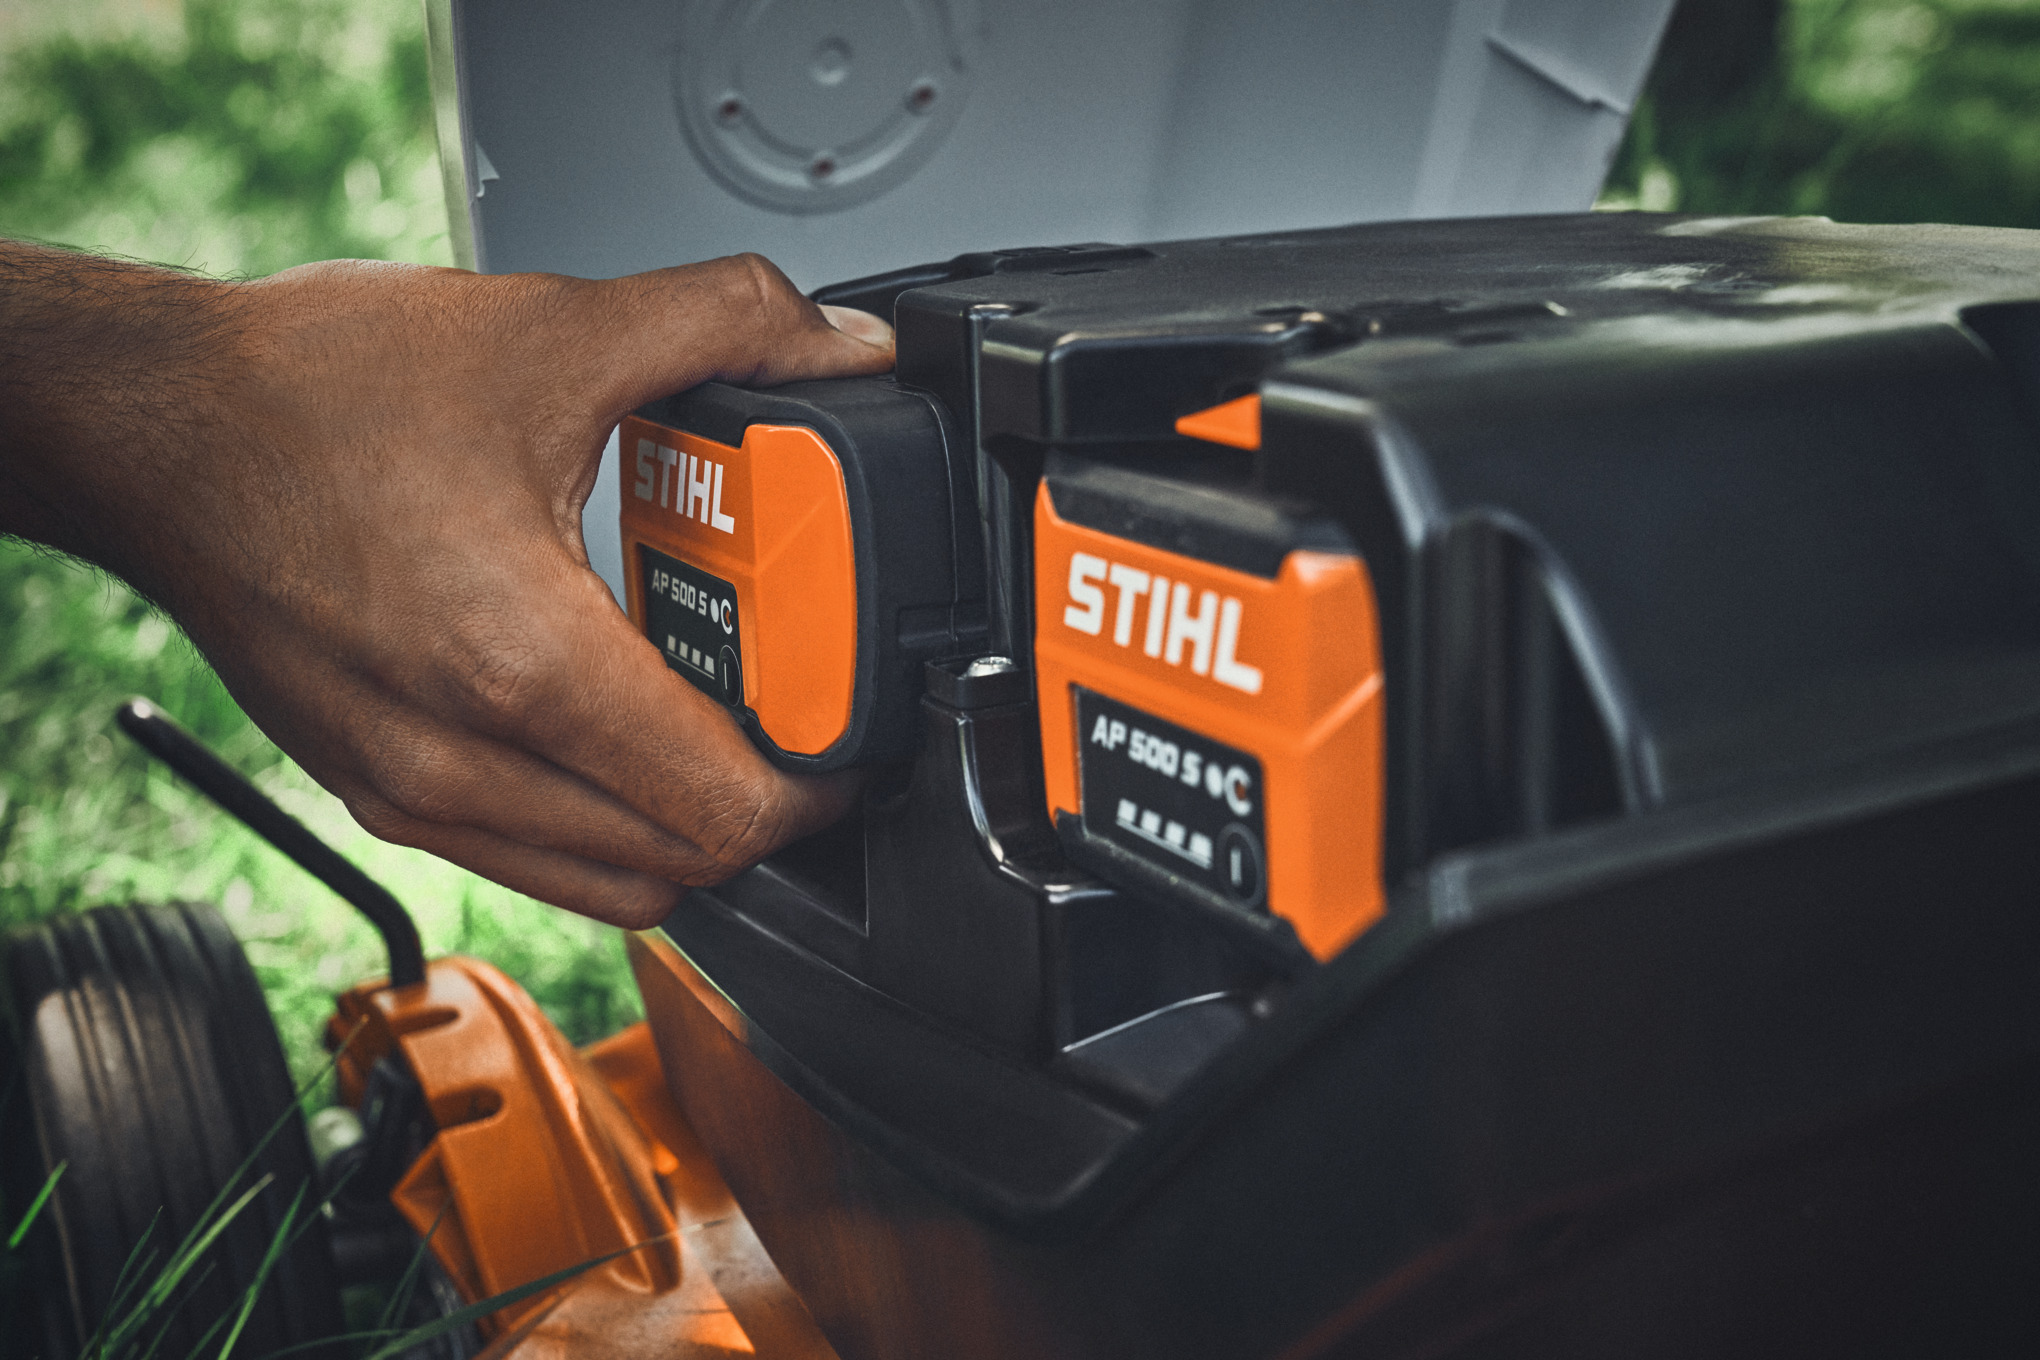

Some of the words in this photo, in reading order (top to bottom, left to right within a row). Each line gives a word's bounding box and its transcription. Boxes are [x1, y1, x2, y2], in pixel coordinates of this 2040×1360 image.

[634, 438, 735, 534] STIHL
[651, 568, 669, 595] AP
[671, 578, 696, 608] 500
[1063, 551, 1263, 695] STIHL
[1091, 714, 1127, 751] AP
[1129, 730, 1178, 776] 500
